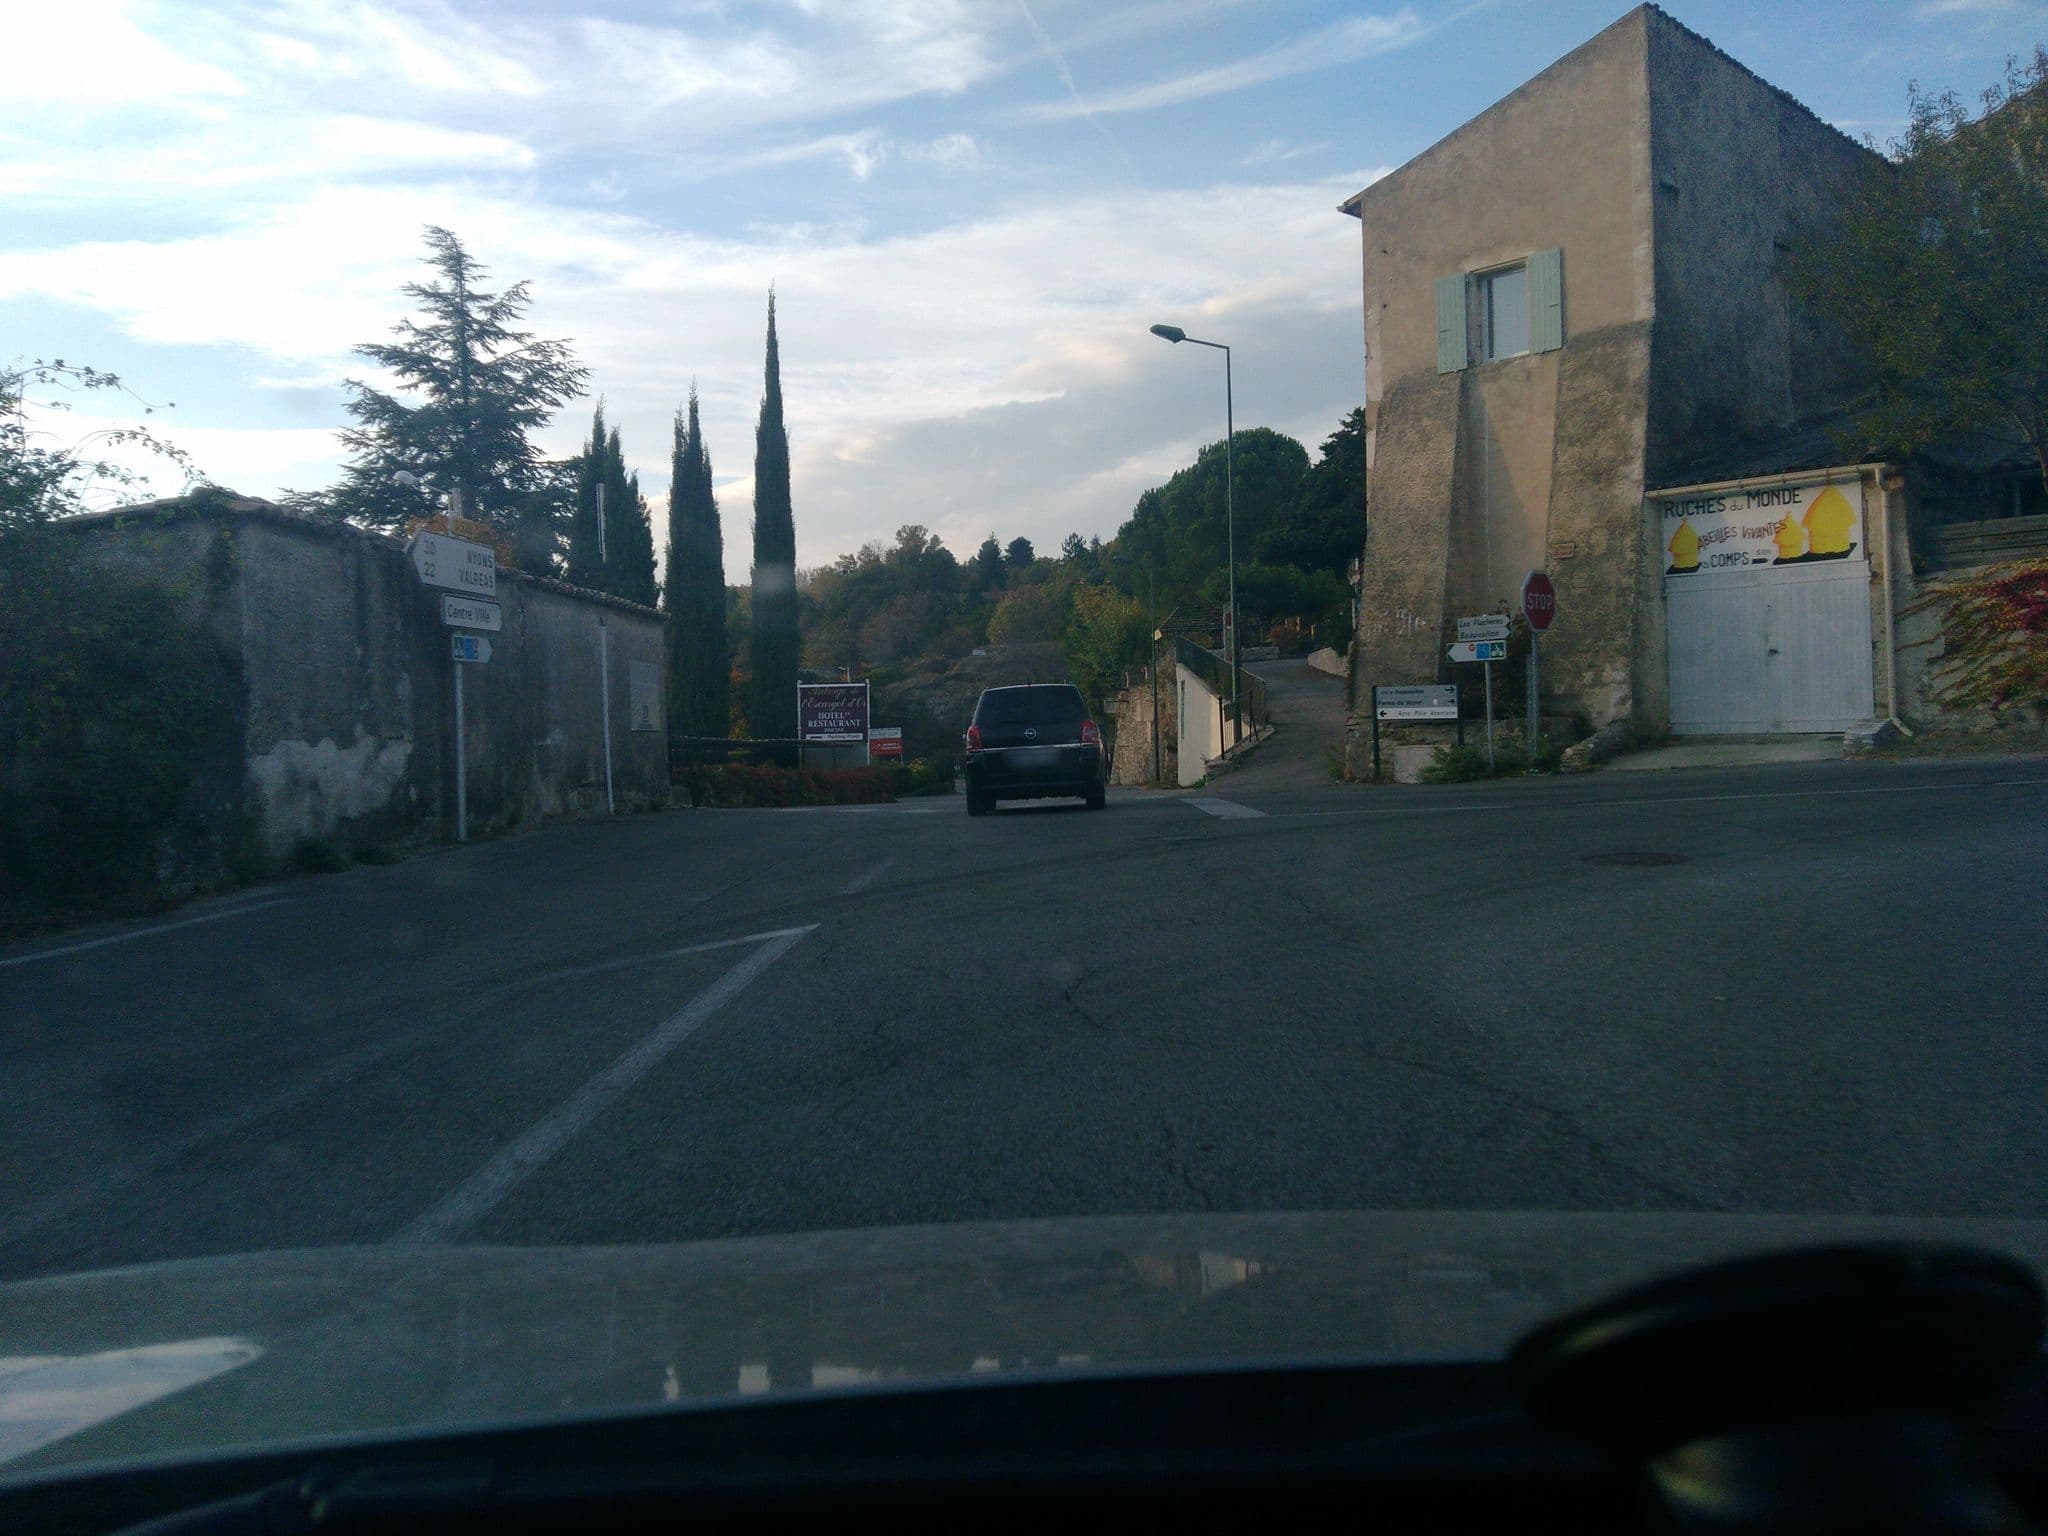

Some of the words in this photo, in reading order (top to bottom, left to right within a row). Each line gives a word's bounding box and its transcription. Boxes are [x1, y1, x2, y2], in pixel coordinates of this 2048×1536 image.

[1663, 497, 1727, 519] RUCHES
[1729, 502, 1743, 512] du
[1746, 486, 1803, 510] MONDE
[1697, 526, 1737, 550] ABEILLES
[467, 550, 494, 569] NYONS
[1710, 551, 1750, 568] COMPS
[423, 561, 436, 578] 22
[458, 568, 494, 589] VALREAS
[1527, 593, 1554, 611] STOP
[447, 603, 473, 621] Centre
[808, 719, 861, 728] RESTAURANT
